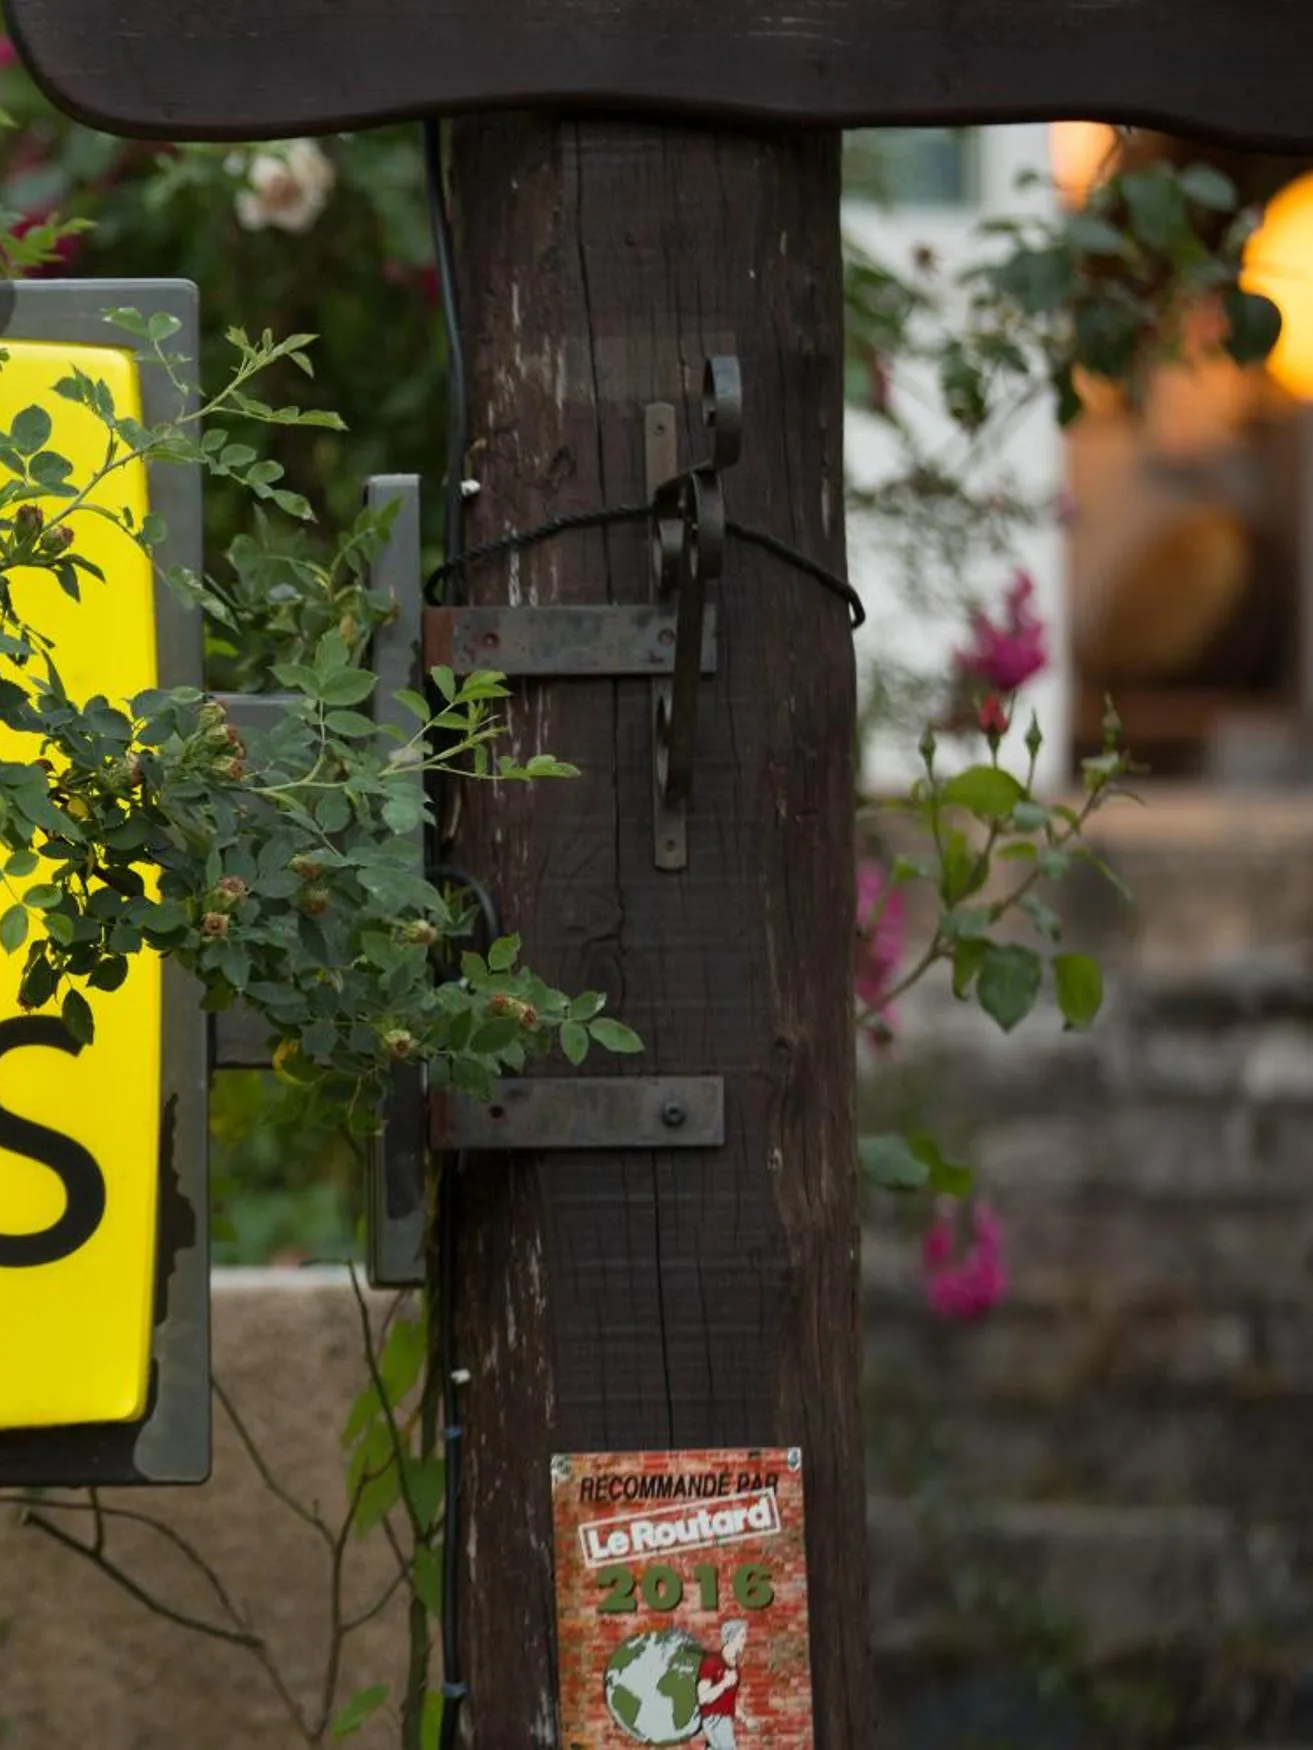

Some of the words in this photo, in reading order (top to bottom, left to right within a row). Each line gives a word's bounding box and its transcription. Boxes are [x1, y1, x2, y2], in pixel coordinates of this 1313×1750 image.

[735, 1471, 779, 1496] PAR
[588, 1528, 630, 1559] Le
[630, 1496, 772, 1550] Routard
[596, 1563, 775, 1613] 2016
